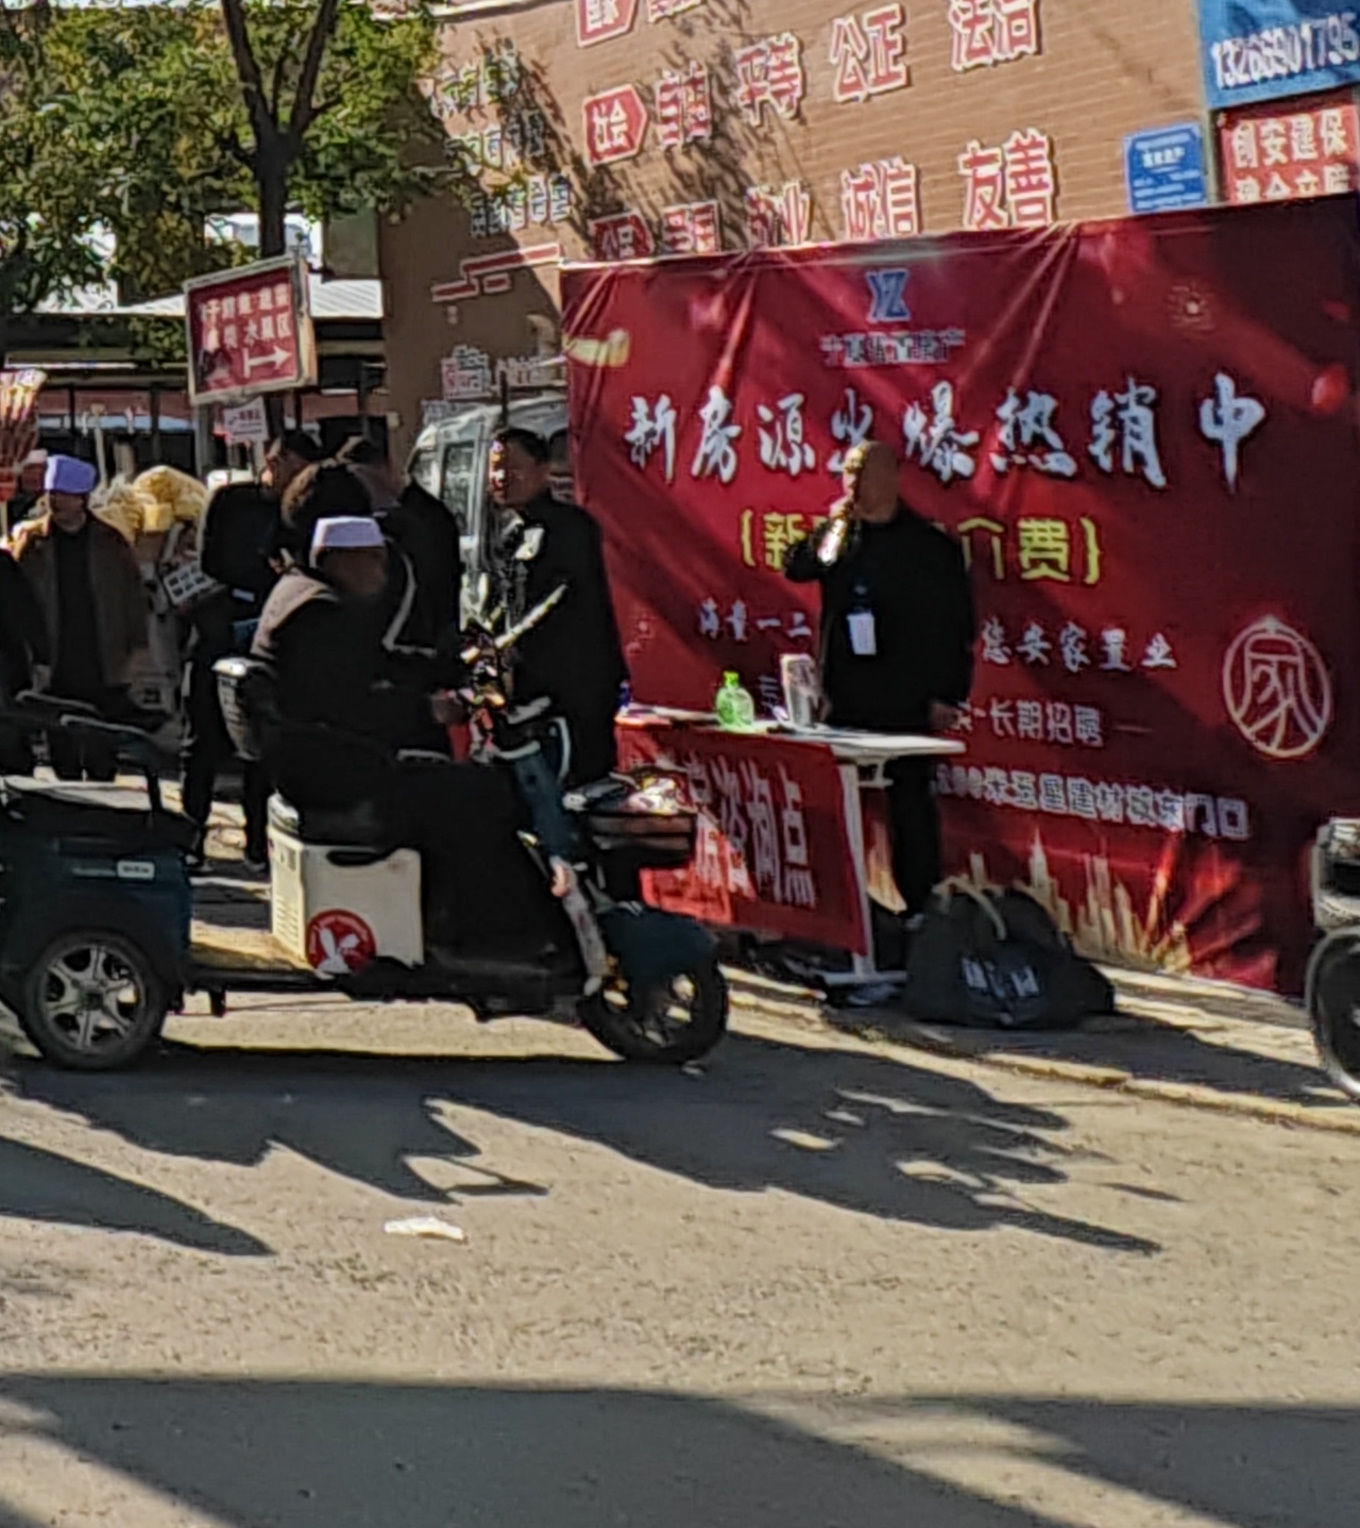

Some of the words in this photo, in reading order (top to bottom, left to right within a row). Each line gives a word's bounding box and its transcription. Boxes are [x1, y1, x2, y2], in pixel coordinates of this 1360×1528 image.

[736, 32, 803, 126] 平等
[829, 3, 909, 102] 公正
[842, 155, 918, 241] 诚信
[958, 128, 1055, 230] 友善
